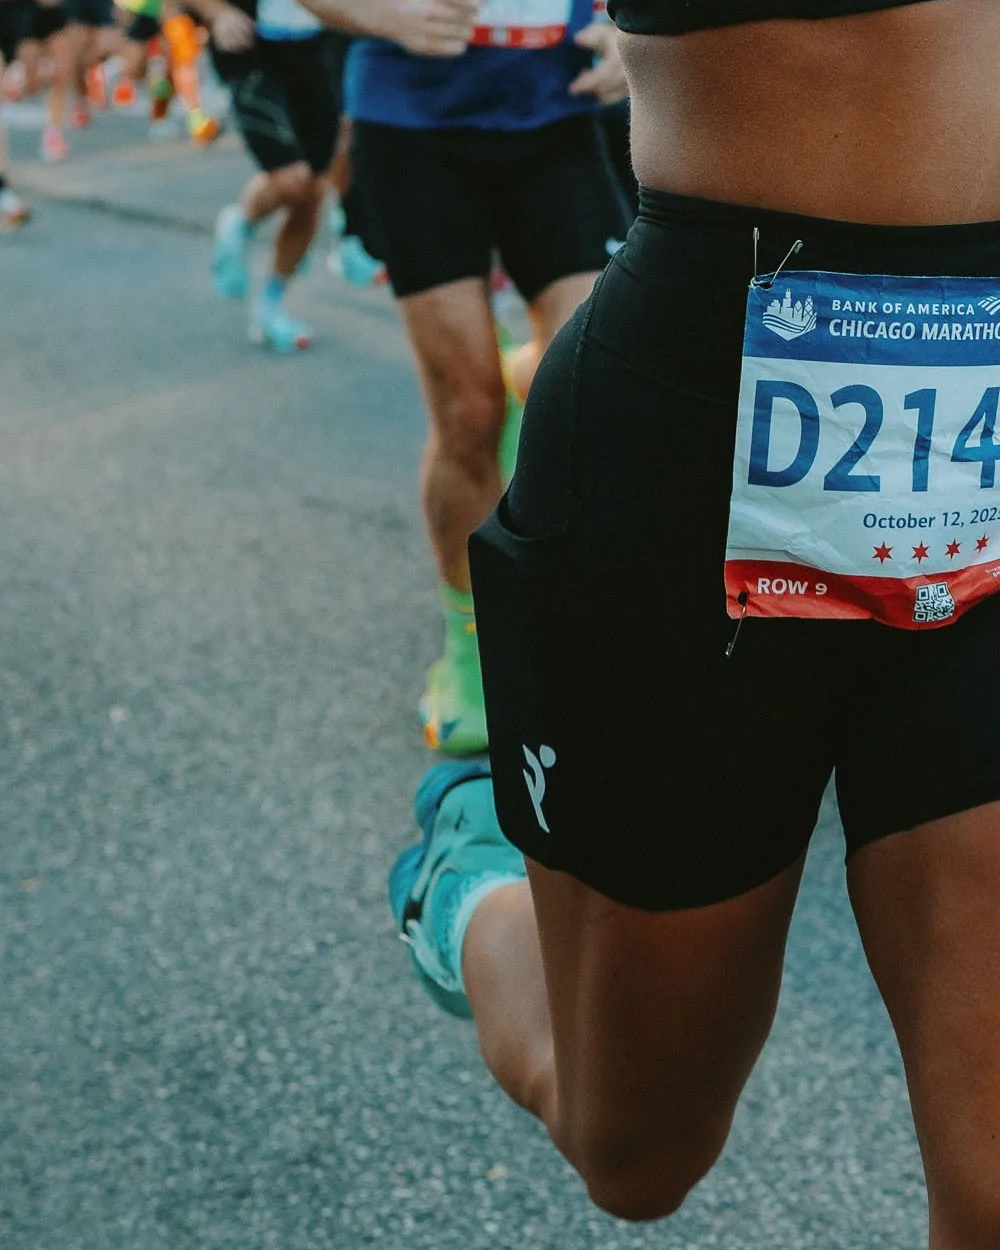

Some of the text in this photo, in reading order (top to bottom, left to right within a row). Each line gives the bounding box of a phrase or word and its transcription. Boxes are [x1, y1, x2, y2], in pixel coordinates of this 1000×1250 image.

[832, 299, 975, 316] BANK OF AMERICA
[829, 318, 916, 340] CHICAGO
[863, 513, 935, 529] October
[942, 512, 965, 528] 12,
[757, 578, 828, 596] ROW 9
